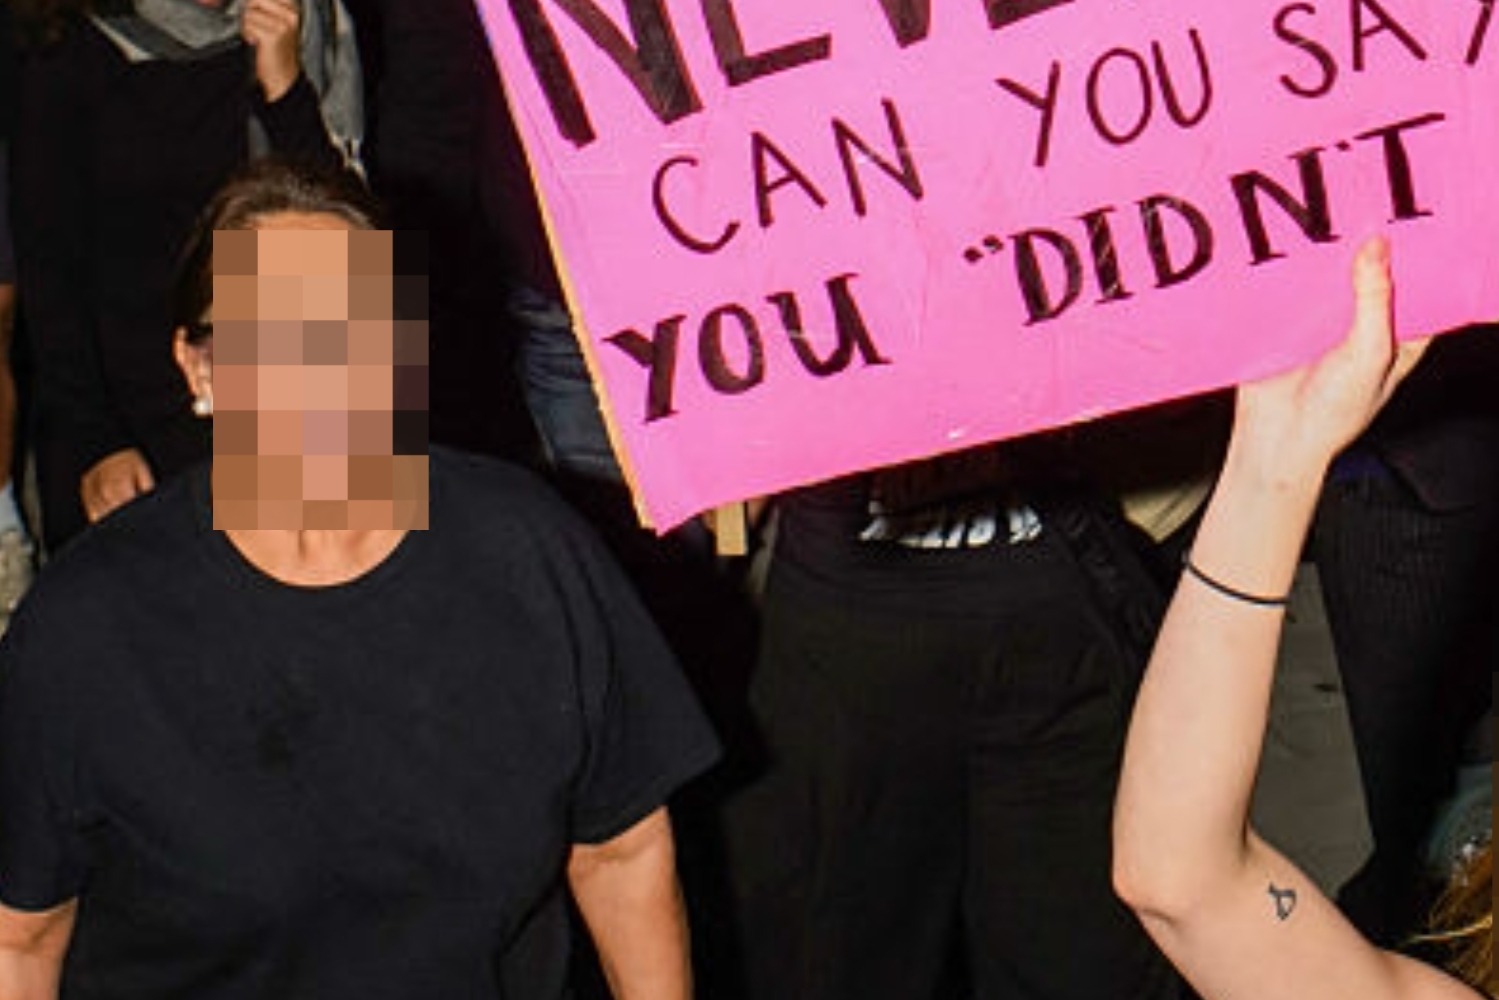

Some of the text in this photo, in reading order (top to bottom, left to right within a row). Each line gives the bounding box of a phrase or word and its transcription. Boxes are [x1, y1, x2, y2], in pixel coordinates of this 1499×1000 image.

[652, 101, 923, 255] CAN
[998, 28, 1212, 167] YOU
[608, 276, 888, 422] YOU
